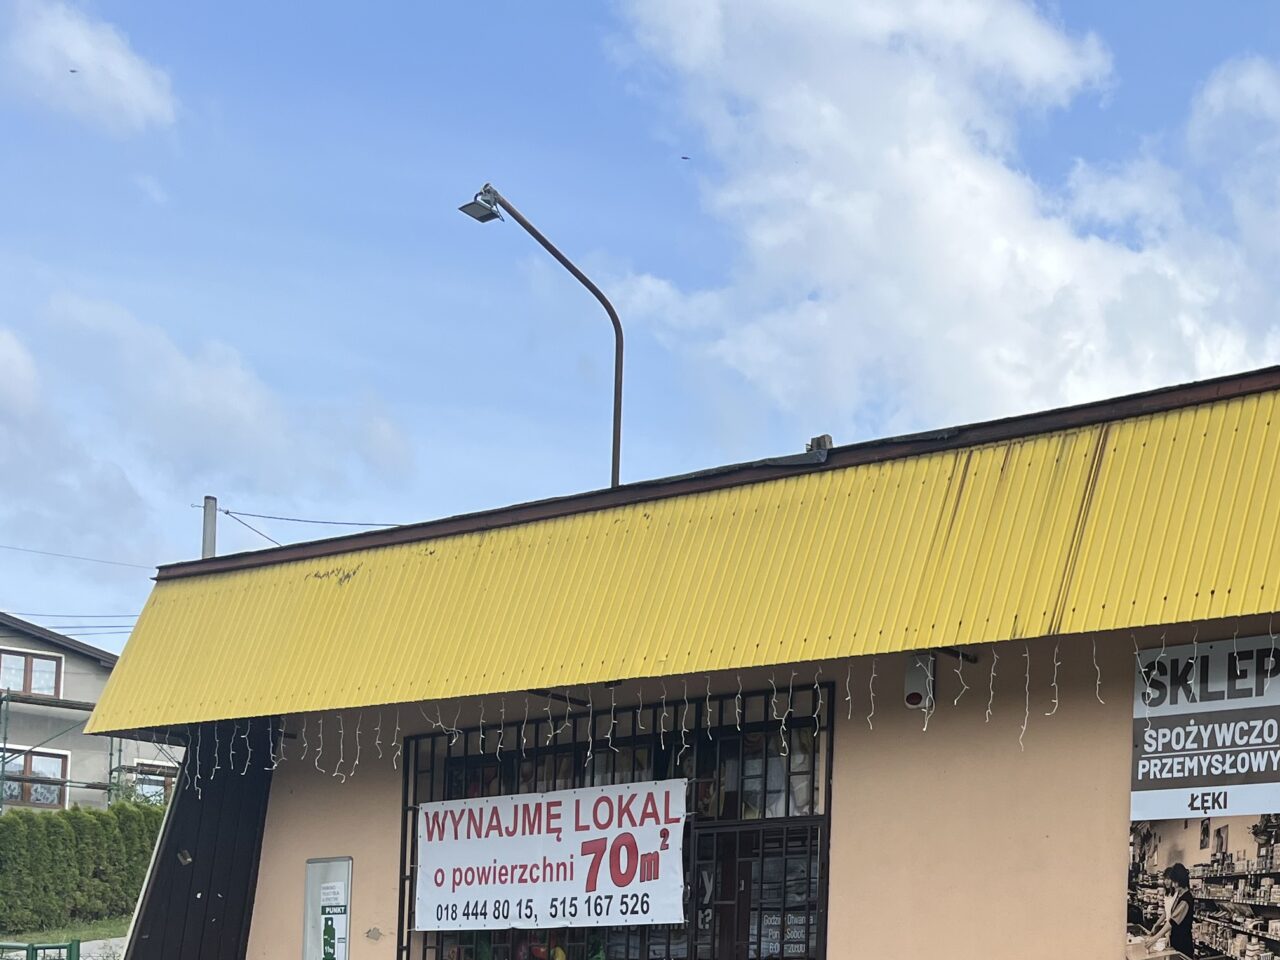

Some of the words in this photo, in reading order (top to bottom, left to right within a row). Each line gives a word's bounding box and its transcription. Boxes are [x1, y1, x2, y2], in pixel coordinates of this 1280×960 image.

[1143, 719, 1279, 753] SPOŻYWCZO
[424, 800, 563, 842] WYNAJMĘ
[574, 790, 681, 833] LOKAL
[1188, 791, 1228, 814] ŁĘKI
[434, 868, 445, 887] o
[452, 855, 574, 892] powierzchni
[325, 906, 345, 914] PUNKT
[436, 902, 458, 921] 018
[462, 900, 488, 920] 444
[493, 899, 510, 919] 80
[516, 898, 538, 922] 15,
[549, 896, 578, 918] 515
[584, 894, 614, 917] 167
[619, 892, 650, 915] 526
[763, 914, 787, 925] Godzi
